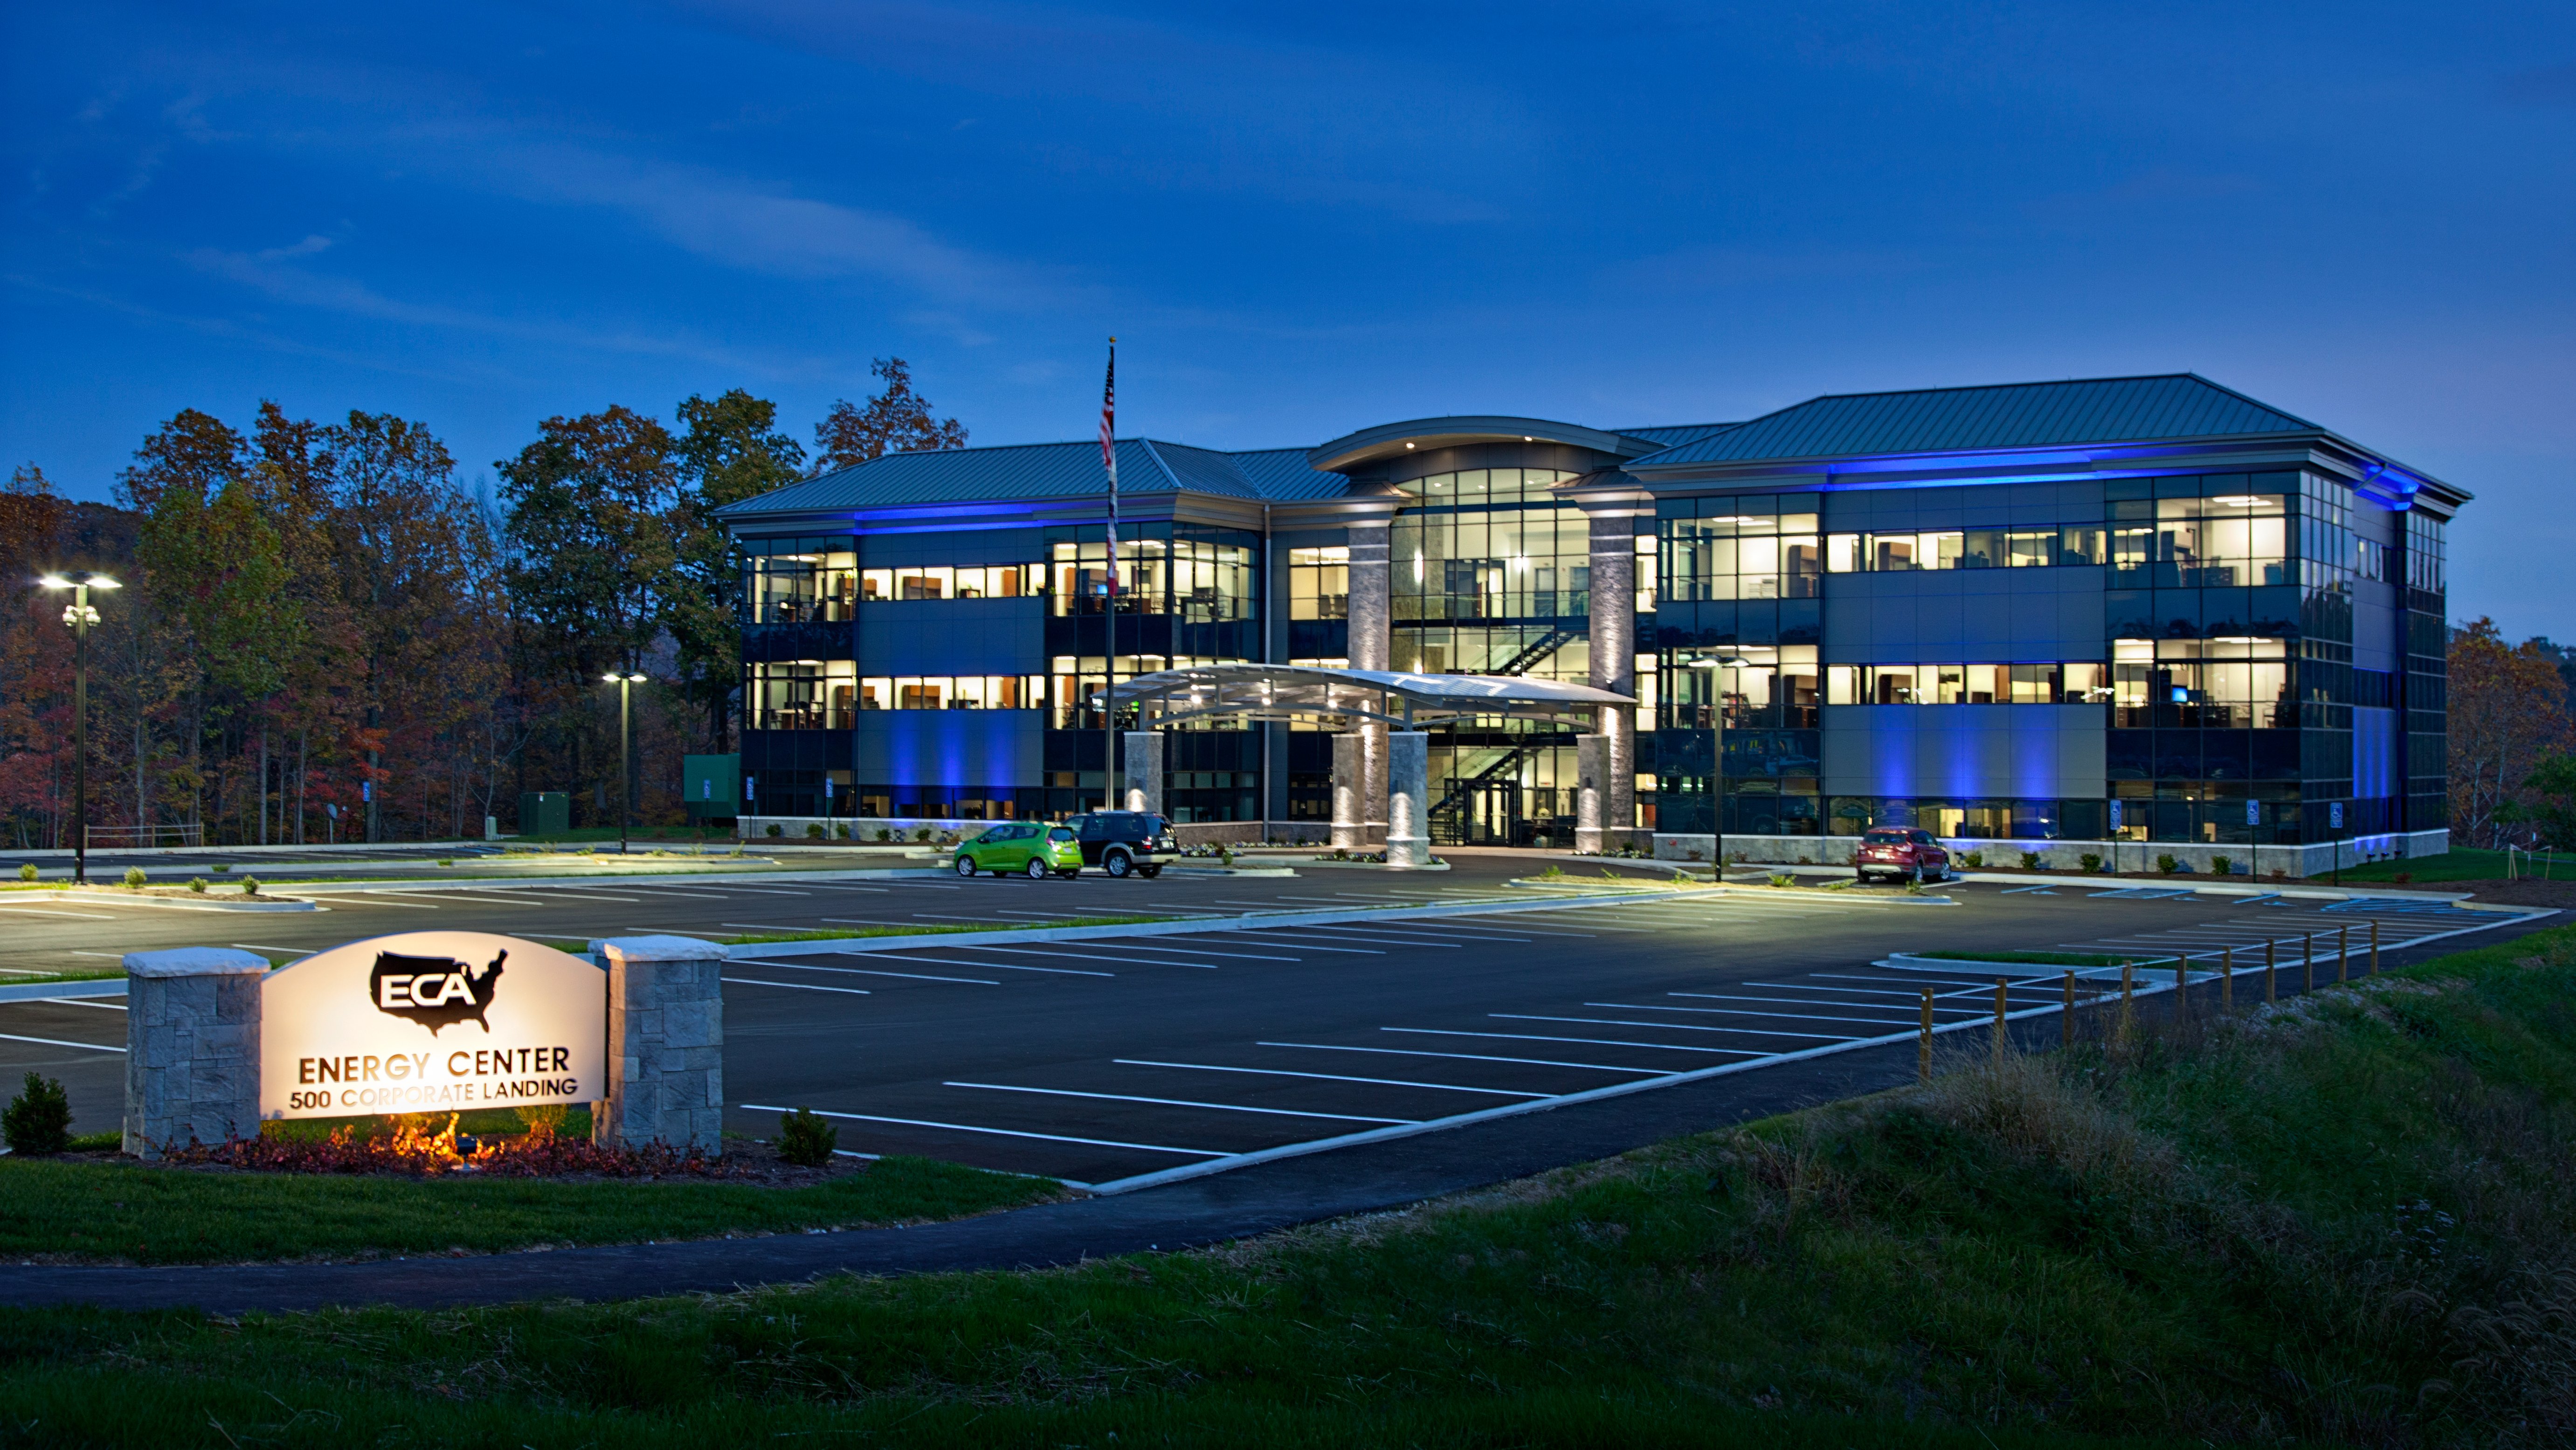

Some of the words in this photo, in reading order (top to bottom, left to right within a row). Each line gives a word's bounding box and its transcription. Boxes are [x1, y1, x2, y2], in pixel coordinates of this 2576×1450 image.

[380, 972, 477, 1008] ECA
[299, 1053, 431, 1084] ENERGY
[447, 1048, 570, 1077] CENTER
[290, 1090, 331, 1110] 500
[341, 1083, 474, 1108] CORPORATE
[483, 1078, 579, 1100] LANDING
